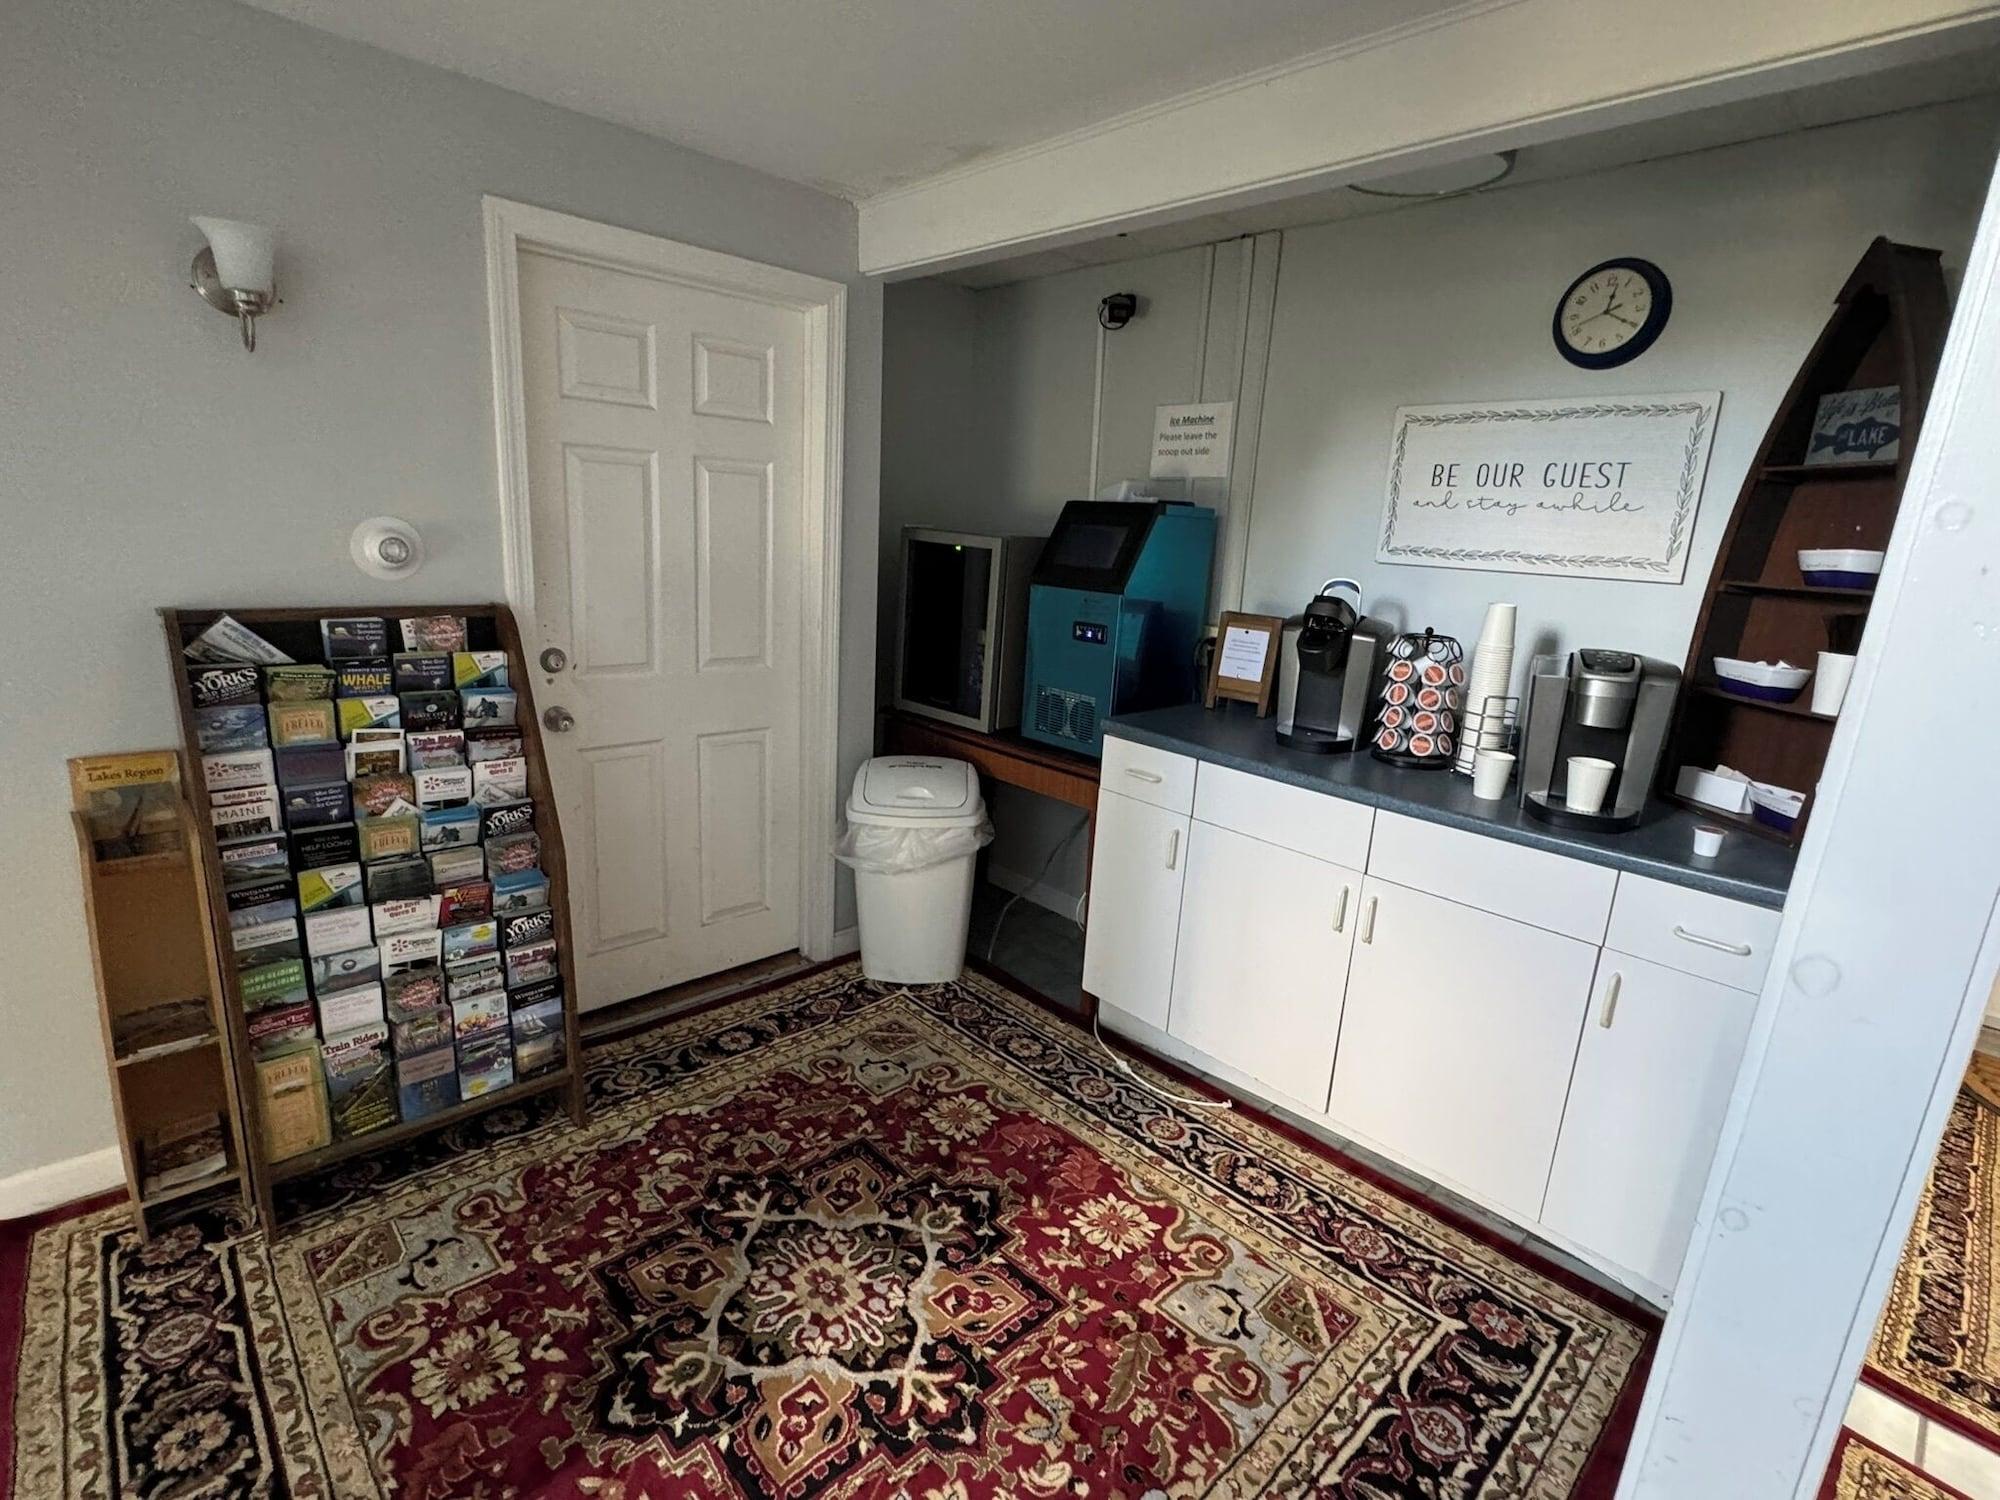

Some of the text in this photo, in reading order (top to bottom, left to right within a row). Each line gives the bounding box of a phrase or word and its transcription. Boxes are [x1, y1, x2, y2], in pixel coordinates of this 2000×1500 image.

[1169, 414, 1215, 426] Ice Machine
[1159, 431, 1217, 442] Please leave the
[1847, 425, 1889, 447] LAKE
[1158, 446, 1210, 457] scoop out side
[1430, 462, 1633, 489] BE OUR GUEST
[1412, 491, 1646, 516] and stay awhile
[194, 667, 258, 694] YORK'S
[342, 673, 392, 686] WHALE
[88, 770, 122, 783] Lakes
[125, 766, 164, 780] Region
[216, 805, 265, 821] MAINE
[486, 804, 533, 830] YORK'S
[505, 911, 552, 938] YORK'S
[323, 1032, 379, 1056] Train Rides
